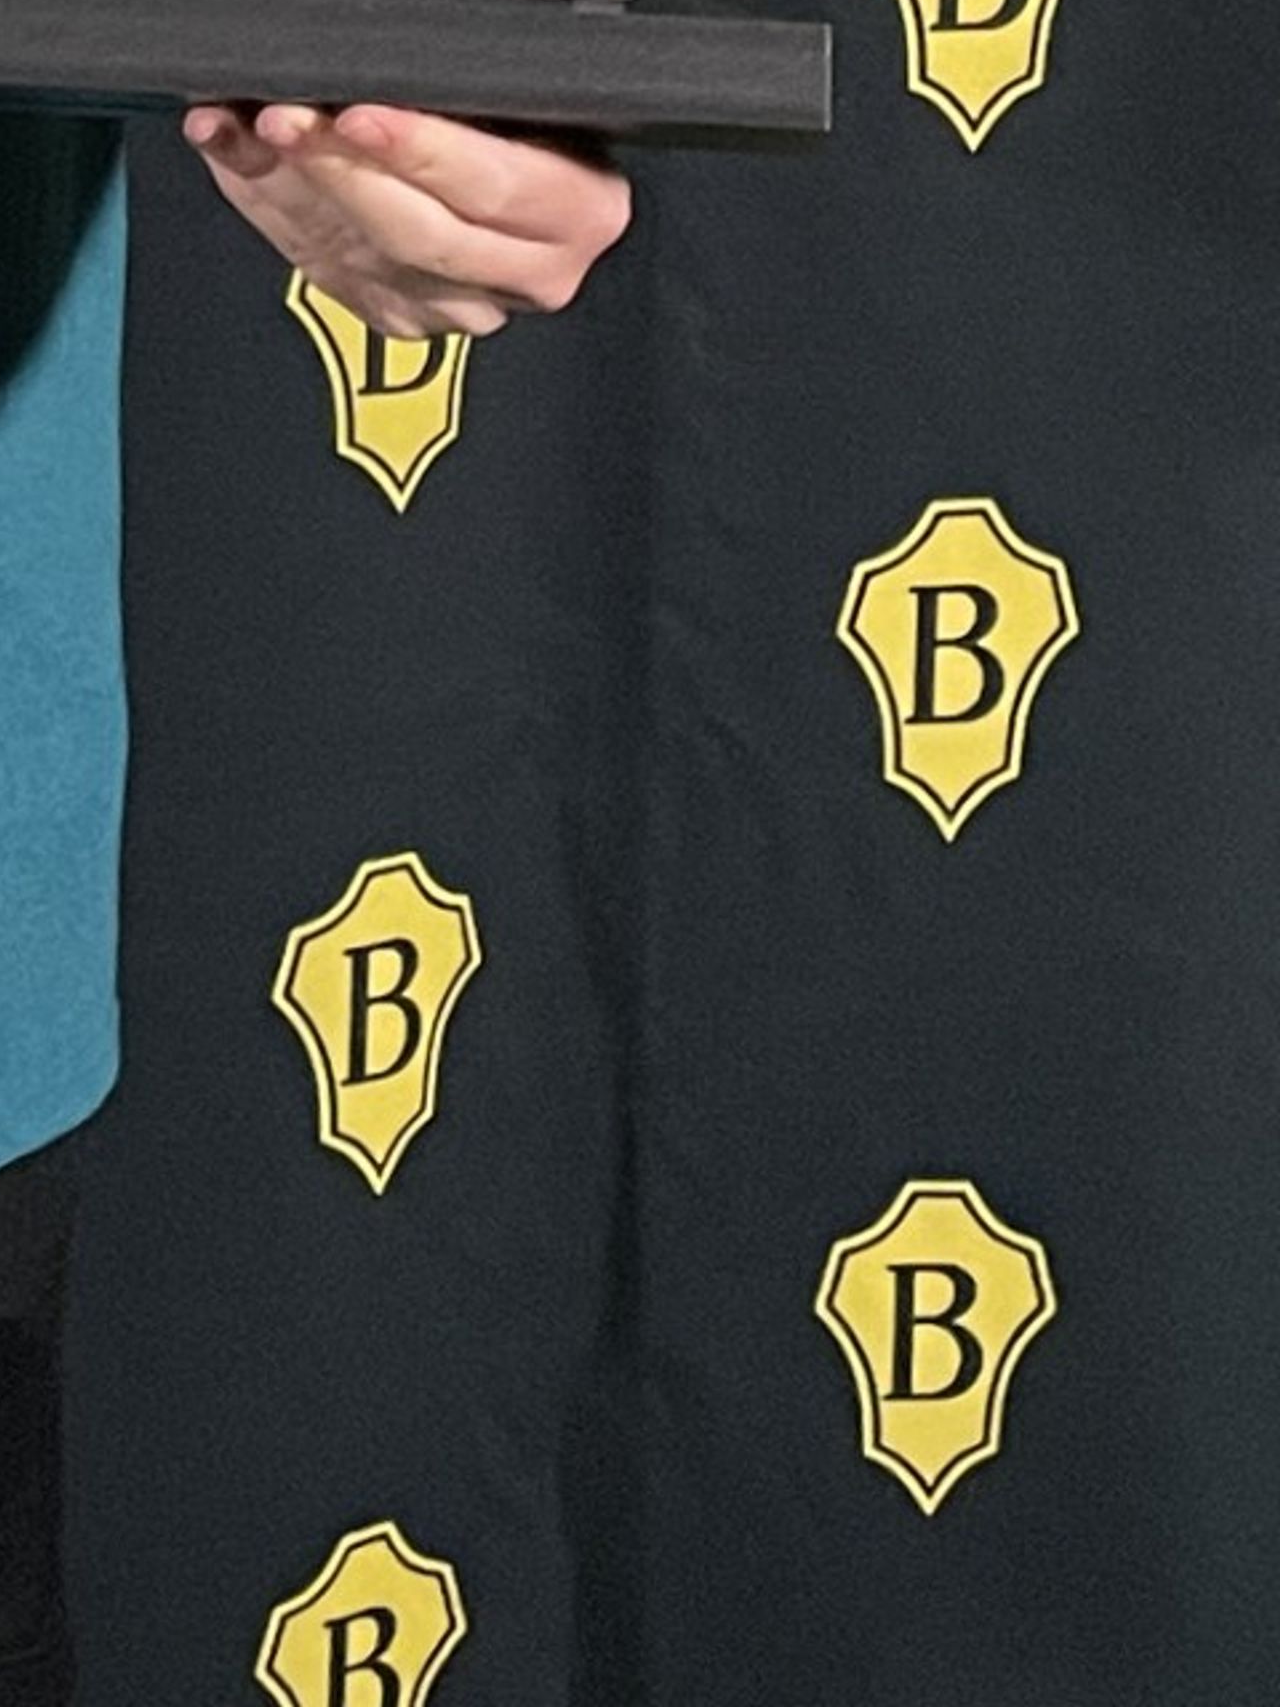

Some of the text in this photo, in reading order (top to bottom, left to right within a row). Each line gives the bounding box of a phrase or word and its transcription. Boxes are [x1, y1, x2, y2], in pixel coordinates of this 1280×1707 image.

[905, 585, 1003, 724] B
[342, 939, 420, 1085] B
[884, 1264, 982, 1400] B
